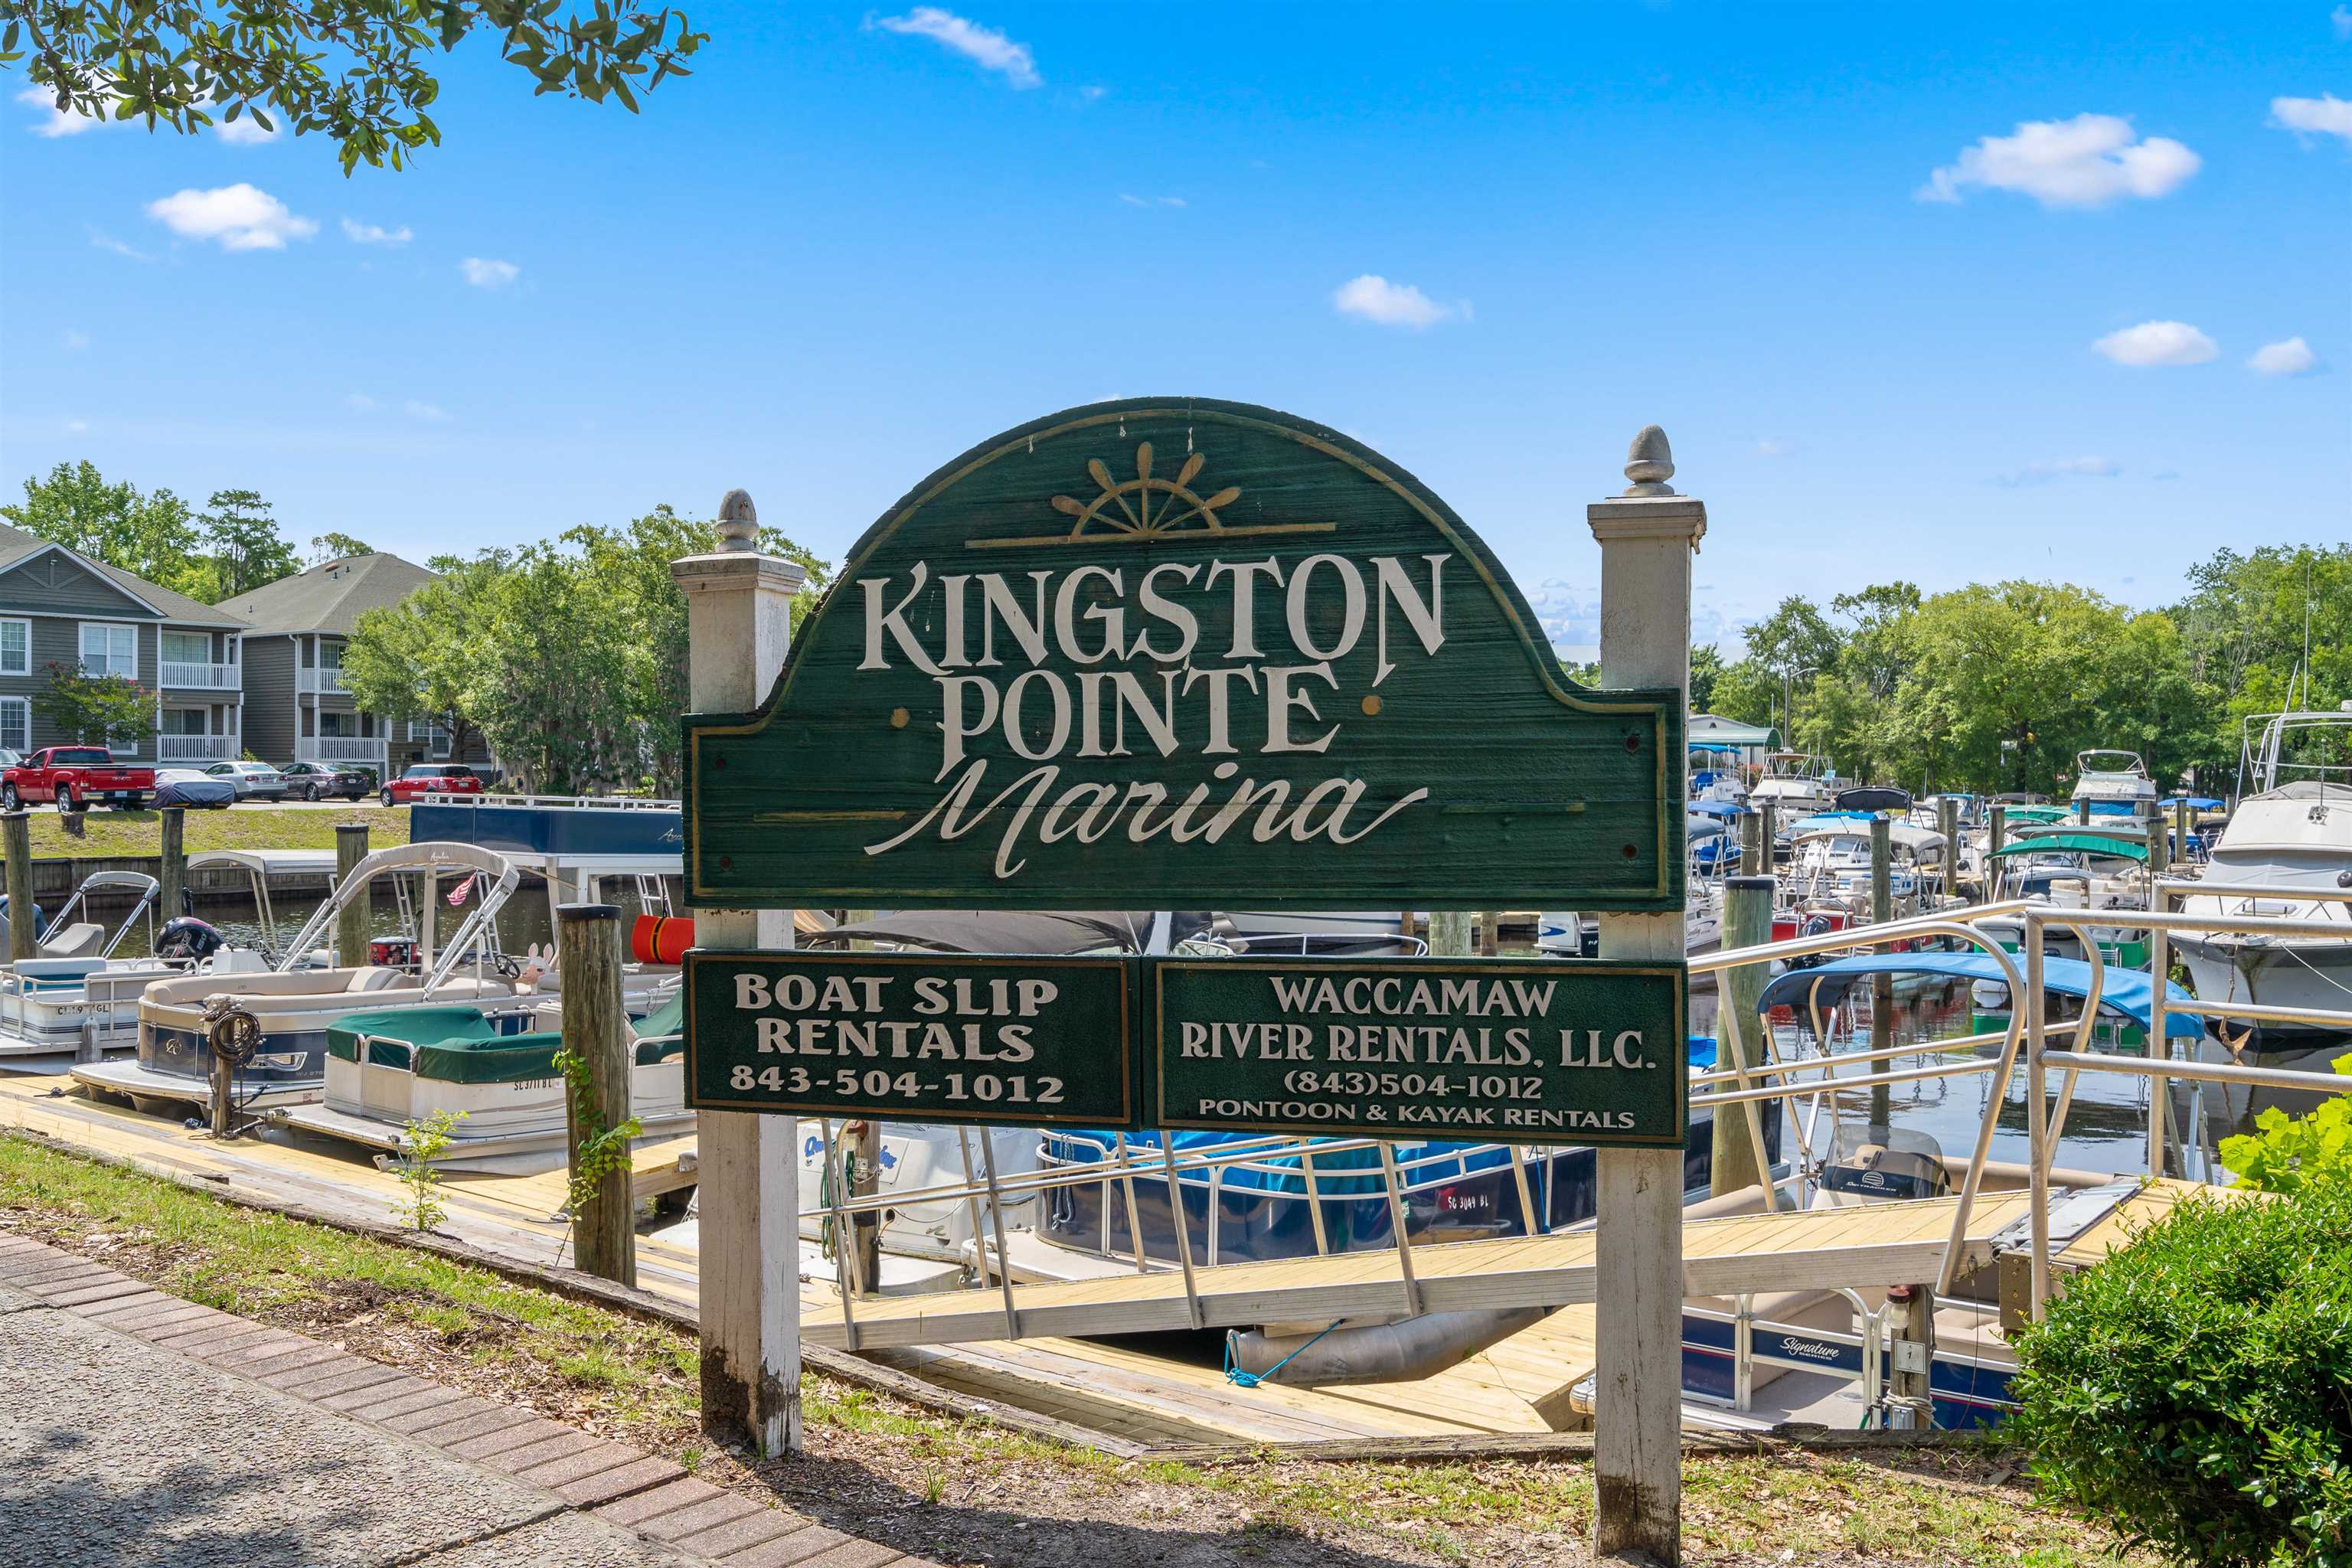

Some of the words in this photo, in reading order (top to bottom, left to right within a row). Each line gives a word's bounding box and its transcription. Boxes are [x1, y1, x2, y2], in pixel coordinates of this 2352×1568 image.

[856, 554, 1452, 688] KINGSTON
[935, 662, 1341, 784] POINTE
[864, 759, 1429, 878] Marina
[733, 973, 894, 1013] BOAT
[912, 977, 1058, 1017] SLIP
[1269, 976, 1558, 1018] WACCAMAW
[754, 1018, 1034, 1063] RENTALS
[1180, 1022, 1314, 1060] RIVER
[1559, 1029, 1657, 1069] LLC.
[729, 1065, 1064, 1102] 843-504-1012
[1284, 1070, 1544, 1099] (843)504-1012
[1199, 1099, 1355, 1120] PONTOON
[1365, 1104, 1388, 1122] &
[1398, 1105, 1494, 1125] KAYAK
[1504, 1108, 1636, 1129] RENTALS
[1448, 1196, 1457, 1209] SC
[1480, 1194, 1489, 1207] BL
[1860, 1184, 1897, 1192] TRACKER
[1779, 1337, 1840, 1357] Signature
